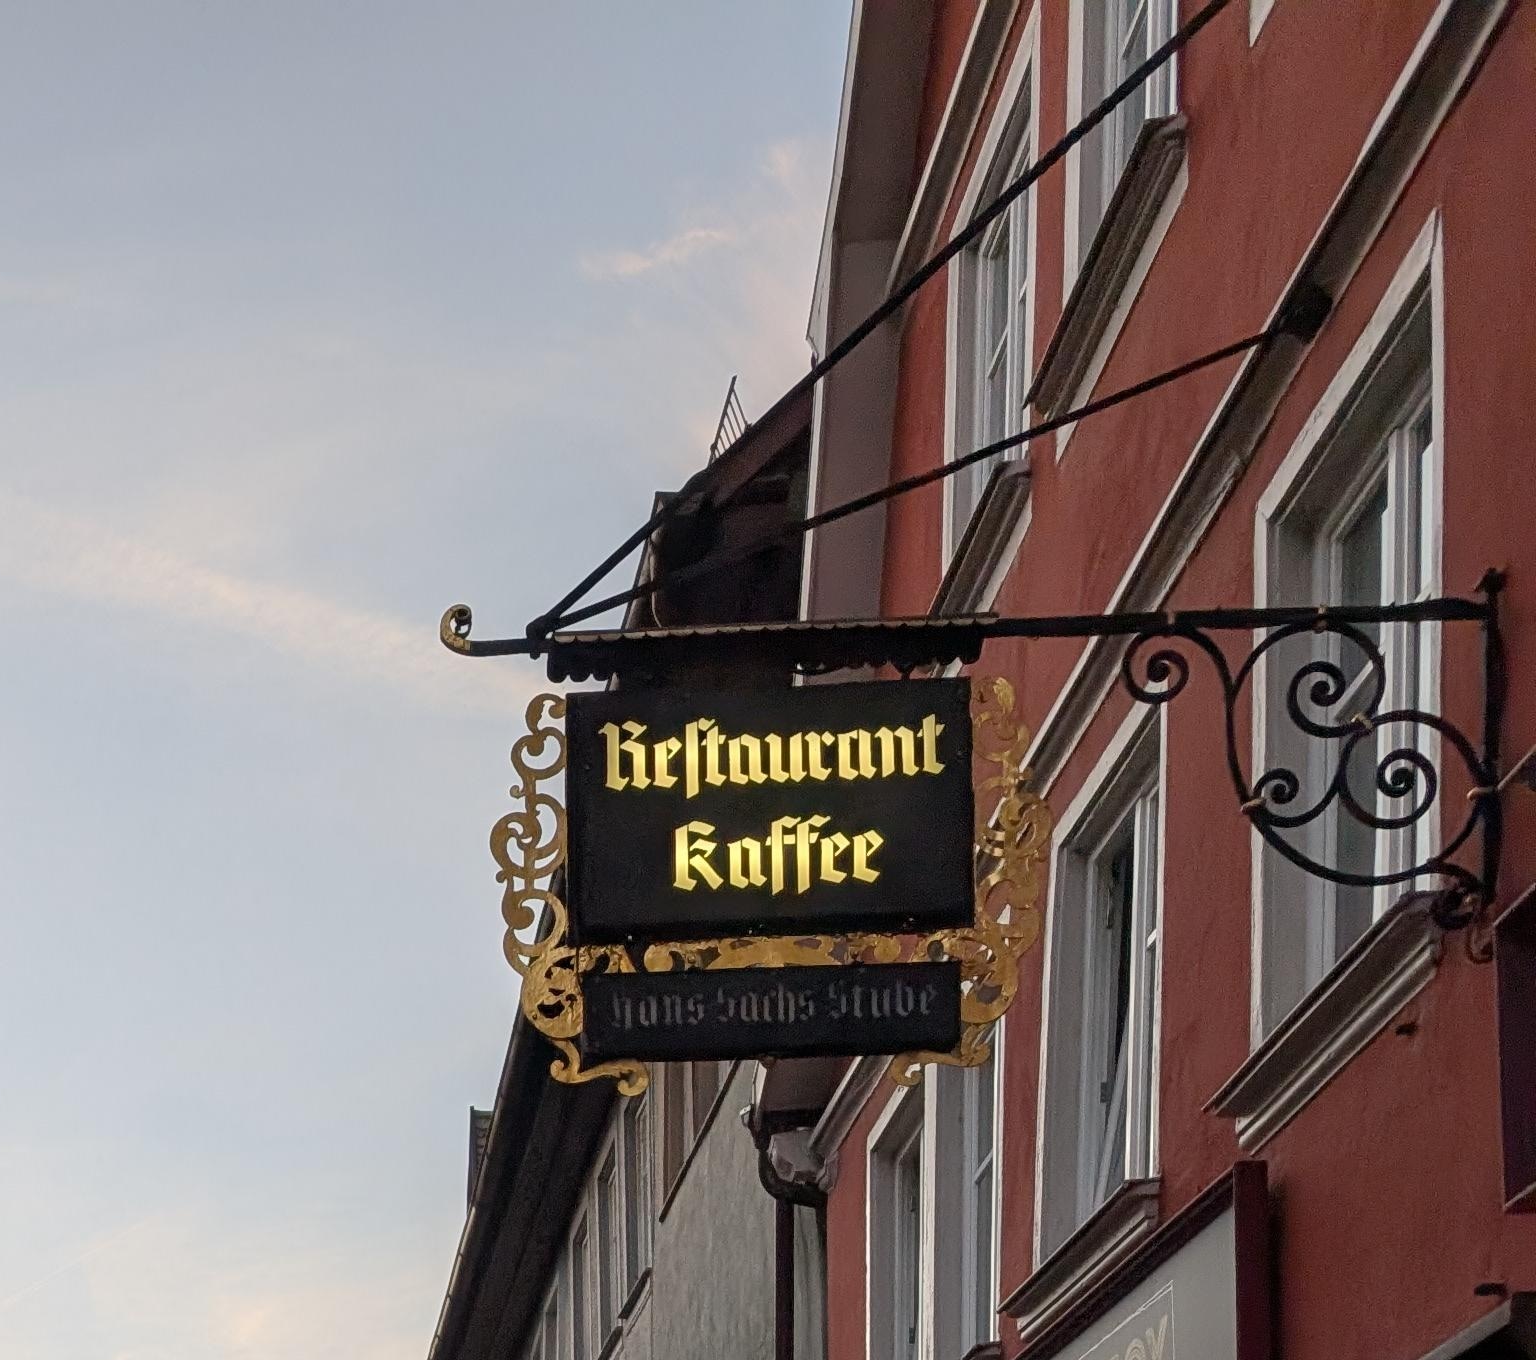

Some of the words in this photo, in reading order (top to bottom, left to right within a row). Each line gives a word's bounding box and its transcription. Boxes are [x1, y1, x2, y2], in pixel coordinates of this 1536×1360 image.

[597, 713, 946, 799] Restaurant
[672, 814, 884, 895] Kaffee
[716, 980, 814, 1024] Sachs
[828, 975, 937, 1019] Stube
